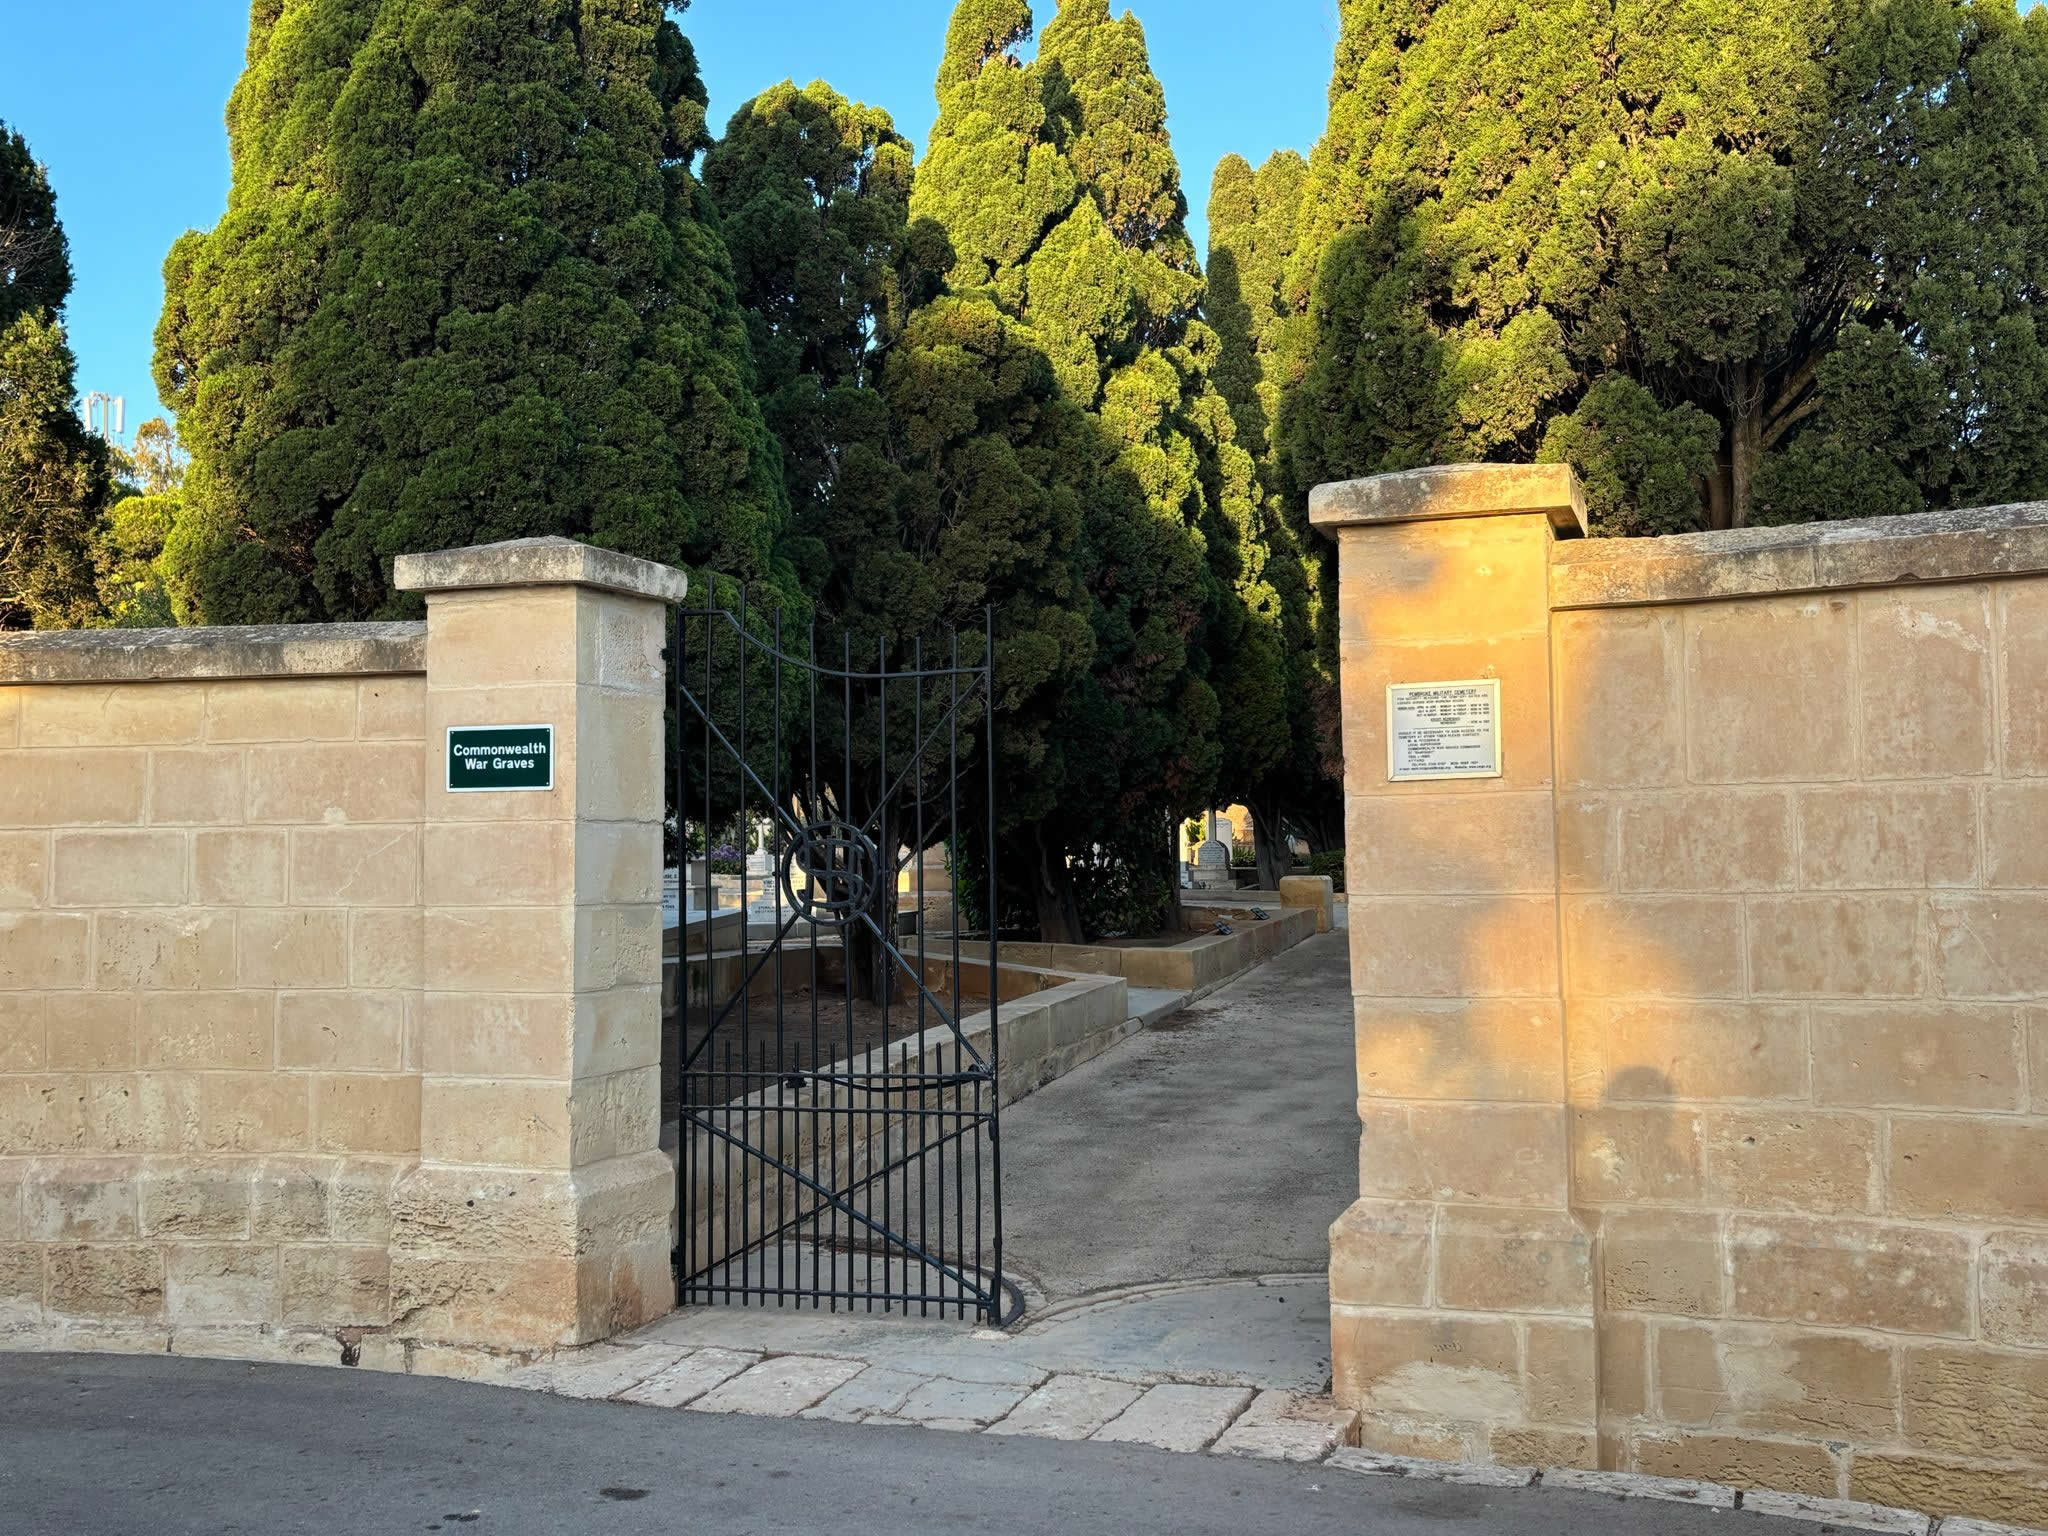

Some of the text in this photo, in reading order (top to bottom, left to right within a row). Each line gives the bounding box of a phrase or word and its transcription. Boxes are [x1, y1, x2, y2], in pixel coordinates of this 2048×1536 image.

[453, 742, 546, 757] Commonwealth
[465, 757, 534, 770] War Graves
